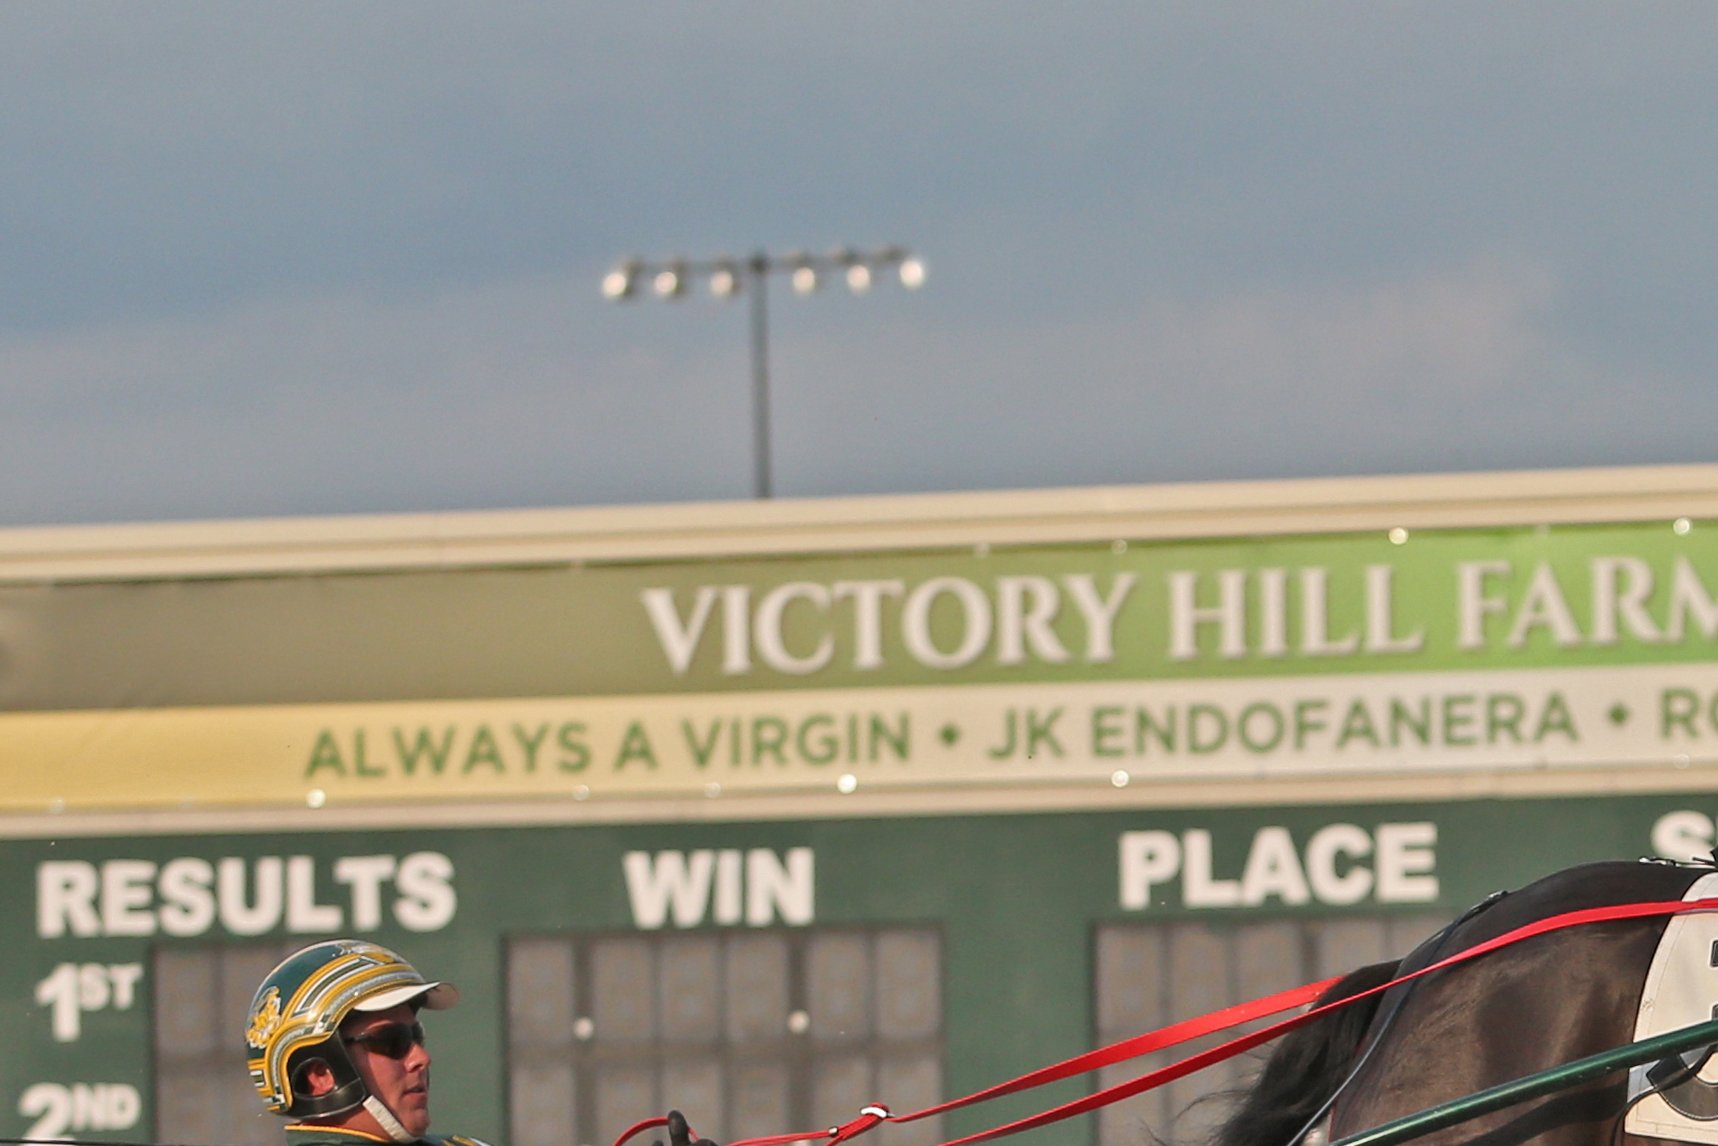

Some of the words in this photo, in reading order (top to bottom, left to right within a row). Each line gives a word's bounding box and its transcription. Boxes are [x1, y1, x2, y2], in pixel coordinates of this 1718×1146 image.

[641, 571, 1137, 677] VICTORY
[1166, 564, 1423, 662] HILL
[304, 720, 594, 779] ALWAYS
[614, 718, 659, 773] A
[680, 708, 912, 769] VIRGIN
[986, 707, 1066, 762] JK
[1090, 692, 1580, 759] ENDOFANERA
[37, 853, 457, 939] RESULTS
[623, 848, 815, 927] WIN
[1118, 822, 1441, 911] PLACE
[32, 964, 143, 1042] 1ST
